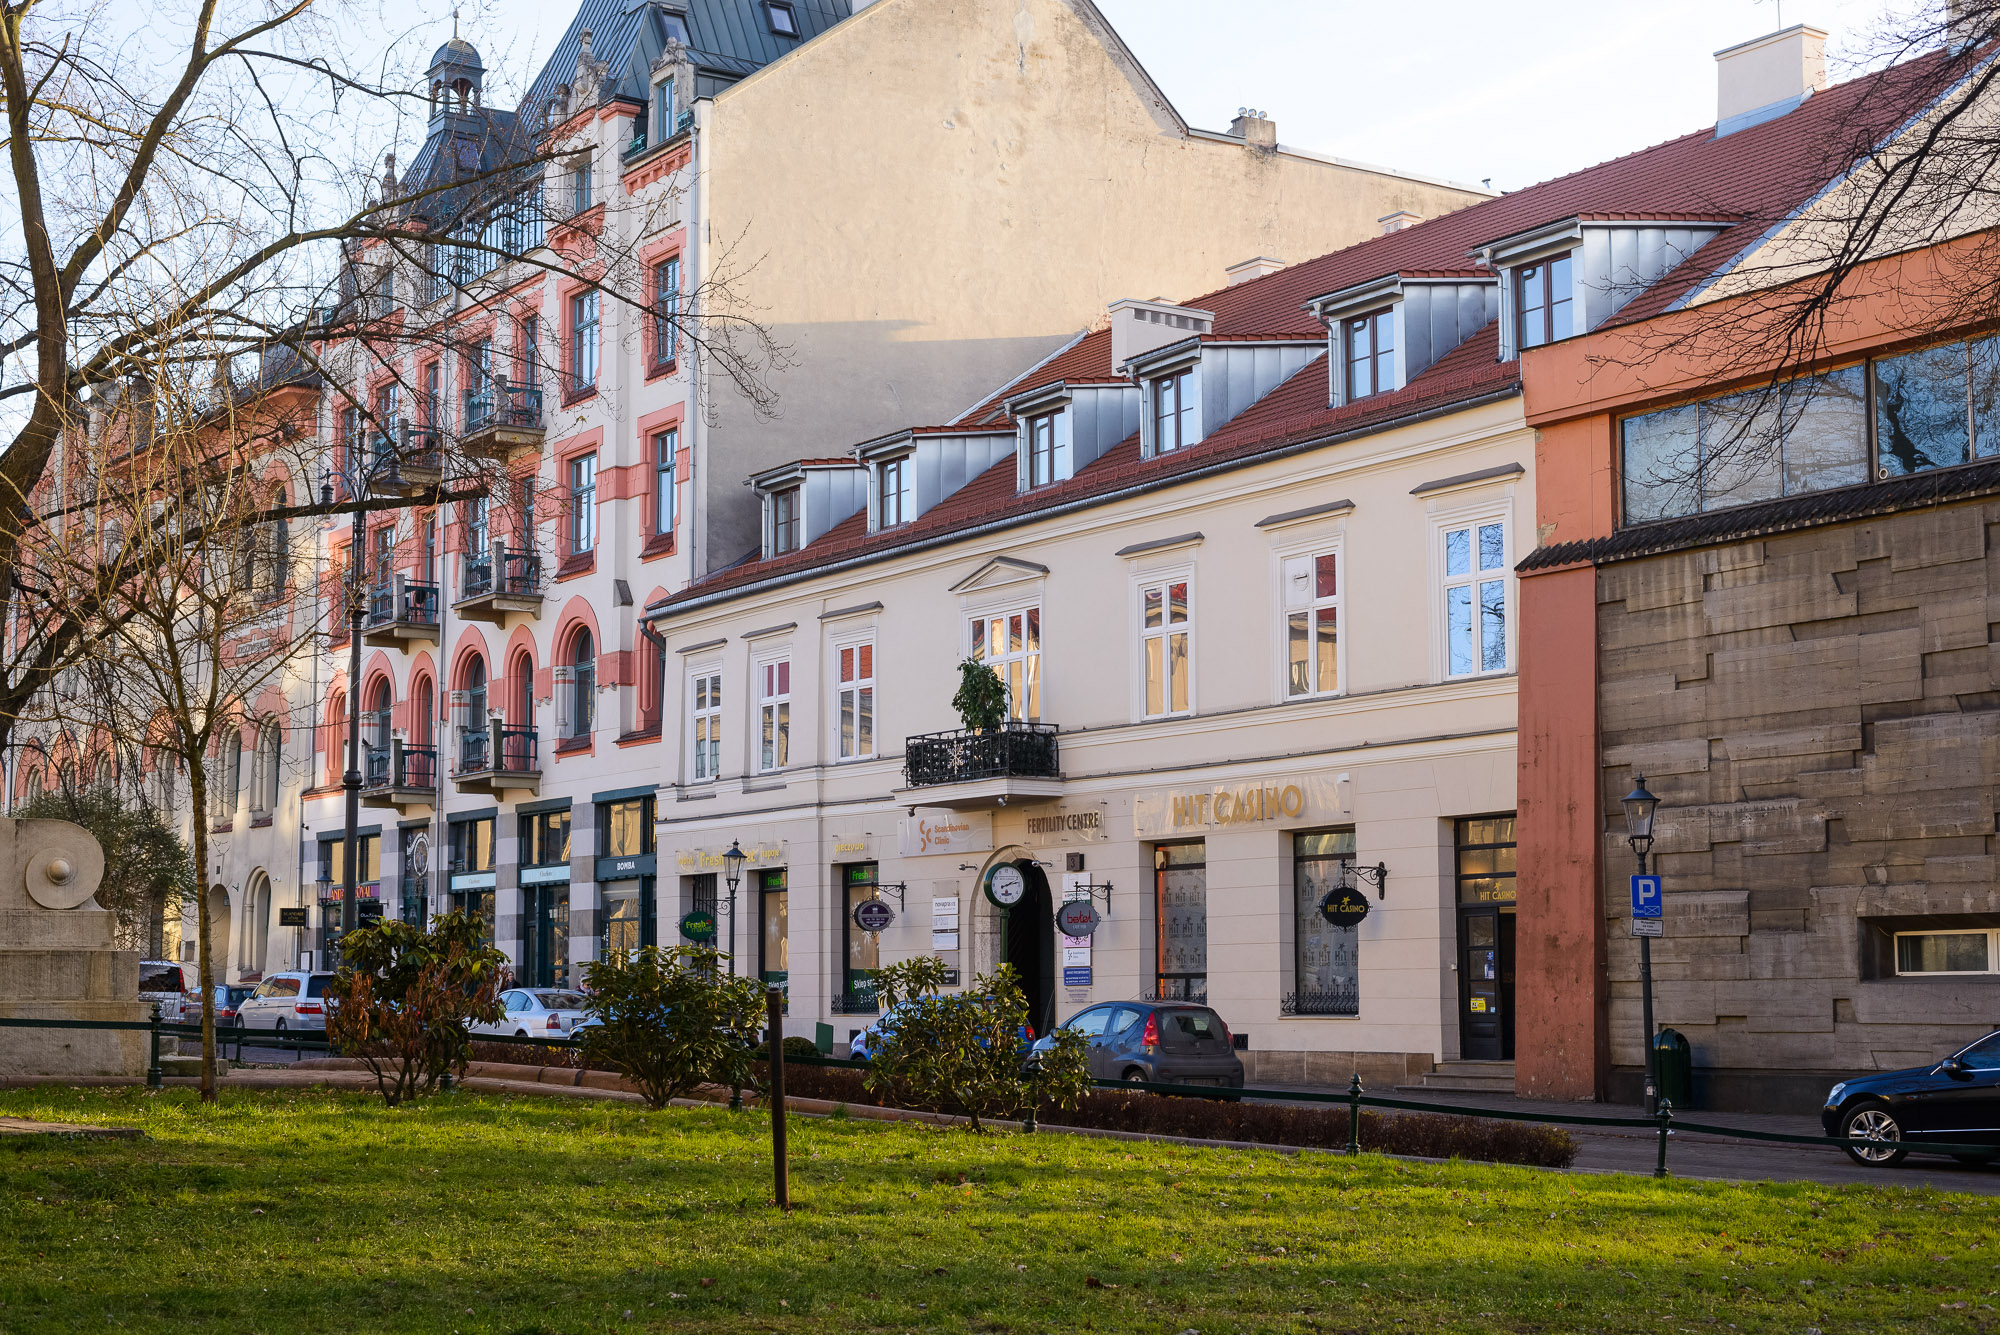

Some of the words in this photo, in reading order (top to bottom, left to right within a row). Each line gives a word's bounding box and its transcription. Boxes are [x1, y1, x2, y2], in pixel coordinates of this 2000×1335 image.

[1173, 794, 1205, 826] HIT
[1214, 784, 1302, 824] CASINO
[1027, 814, 1065, 834] FERTILITY
[1066, 811, 1099, 830] CENTRE
[934, 836, 950, 844] Clinic
[834, 842, 864, 854] pieczywo
[700, 851, 725, 868] Fresh
[761, 848, 780, 860] napoje
[1070, 857, 1076, 868] 3
[616, 860, 636, 871] BOMBA
[851, 869, 869, 880] Fresh
[1479, 891, 1491, 901] HIT
[1492, 890, 1517, 900] CASINO
[1638, 879, 1656, 905] P
[1327, 904, 1338, 913] HIT
[1340, 904, 1365, 913] CASINO
[685, 919, 706, 929] Fresh
[854, 979, 866, 989] Sklep
